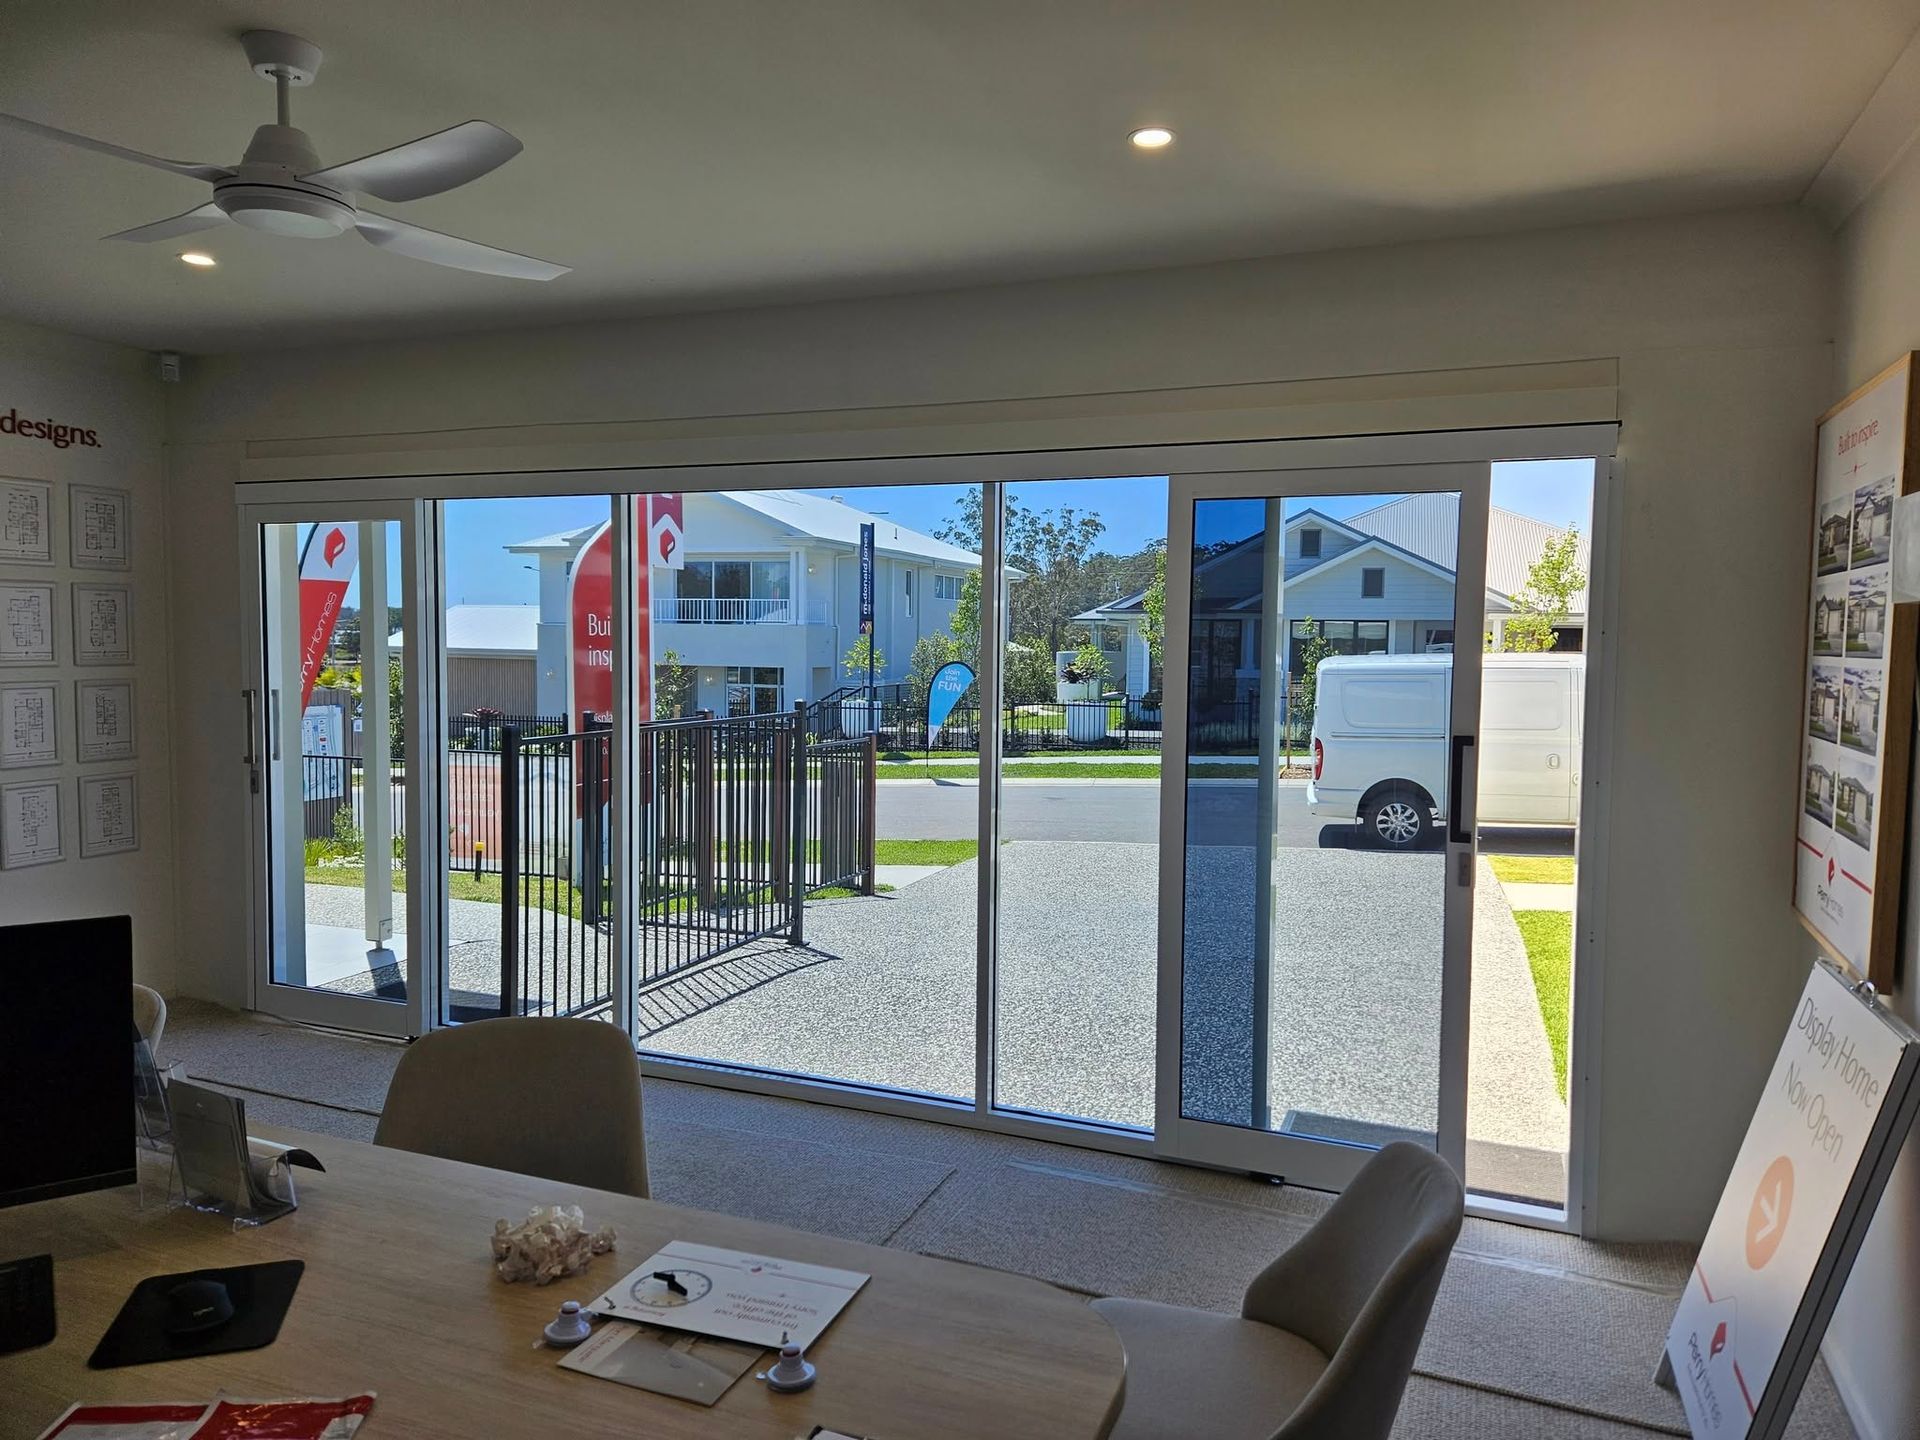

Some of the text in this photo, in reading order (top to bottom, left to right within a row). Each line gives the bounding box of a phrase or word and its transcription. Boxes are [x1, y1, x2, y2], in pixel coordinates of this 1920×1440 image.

[0, 408, 102, 448] designs.
[299, 591, 337, 692] rry Homes
[588, 613, 611, 636] Bui
[938, 681, 961, 691] FUN
[1797, 997, 1879, 1108] Display Home
[1782, 1060, 1844, 1163] Now Open
